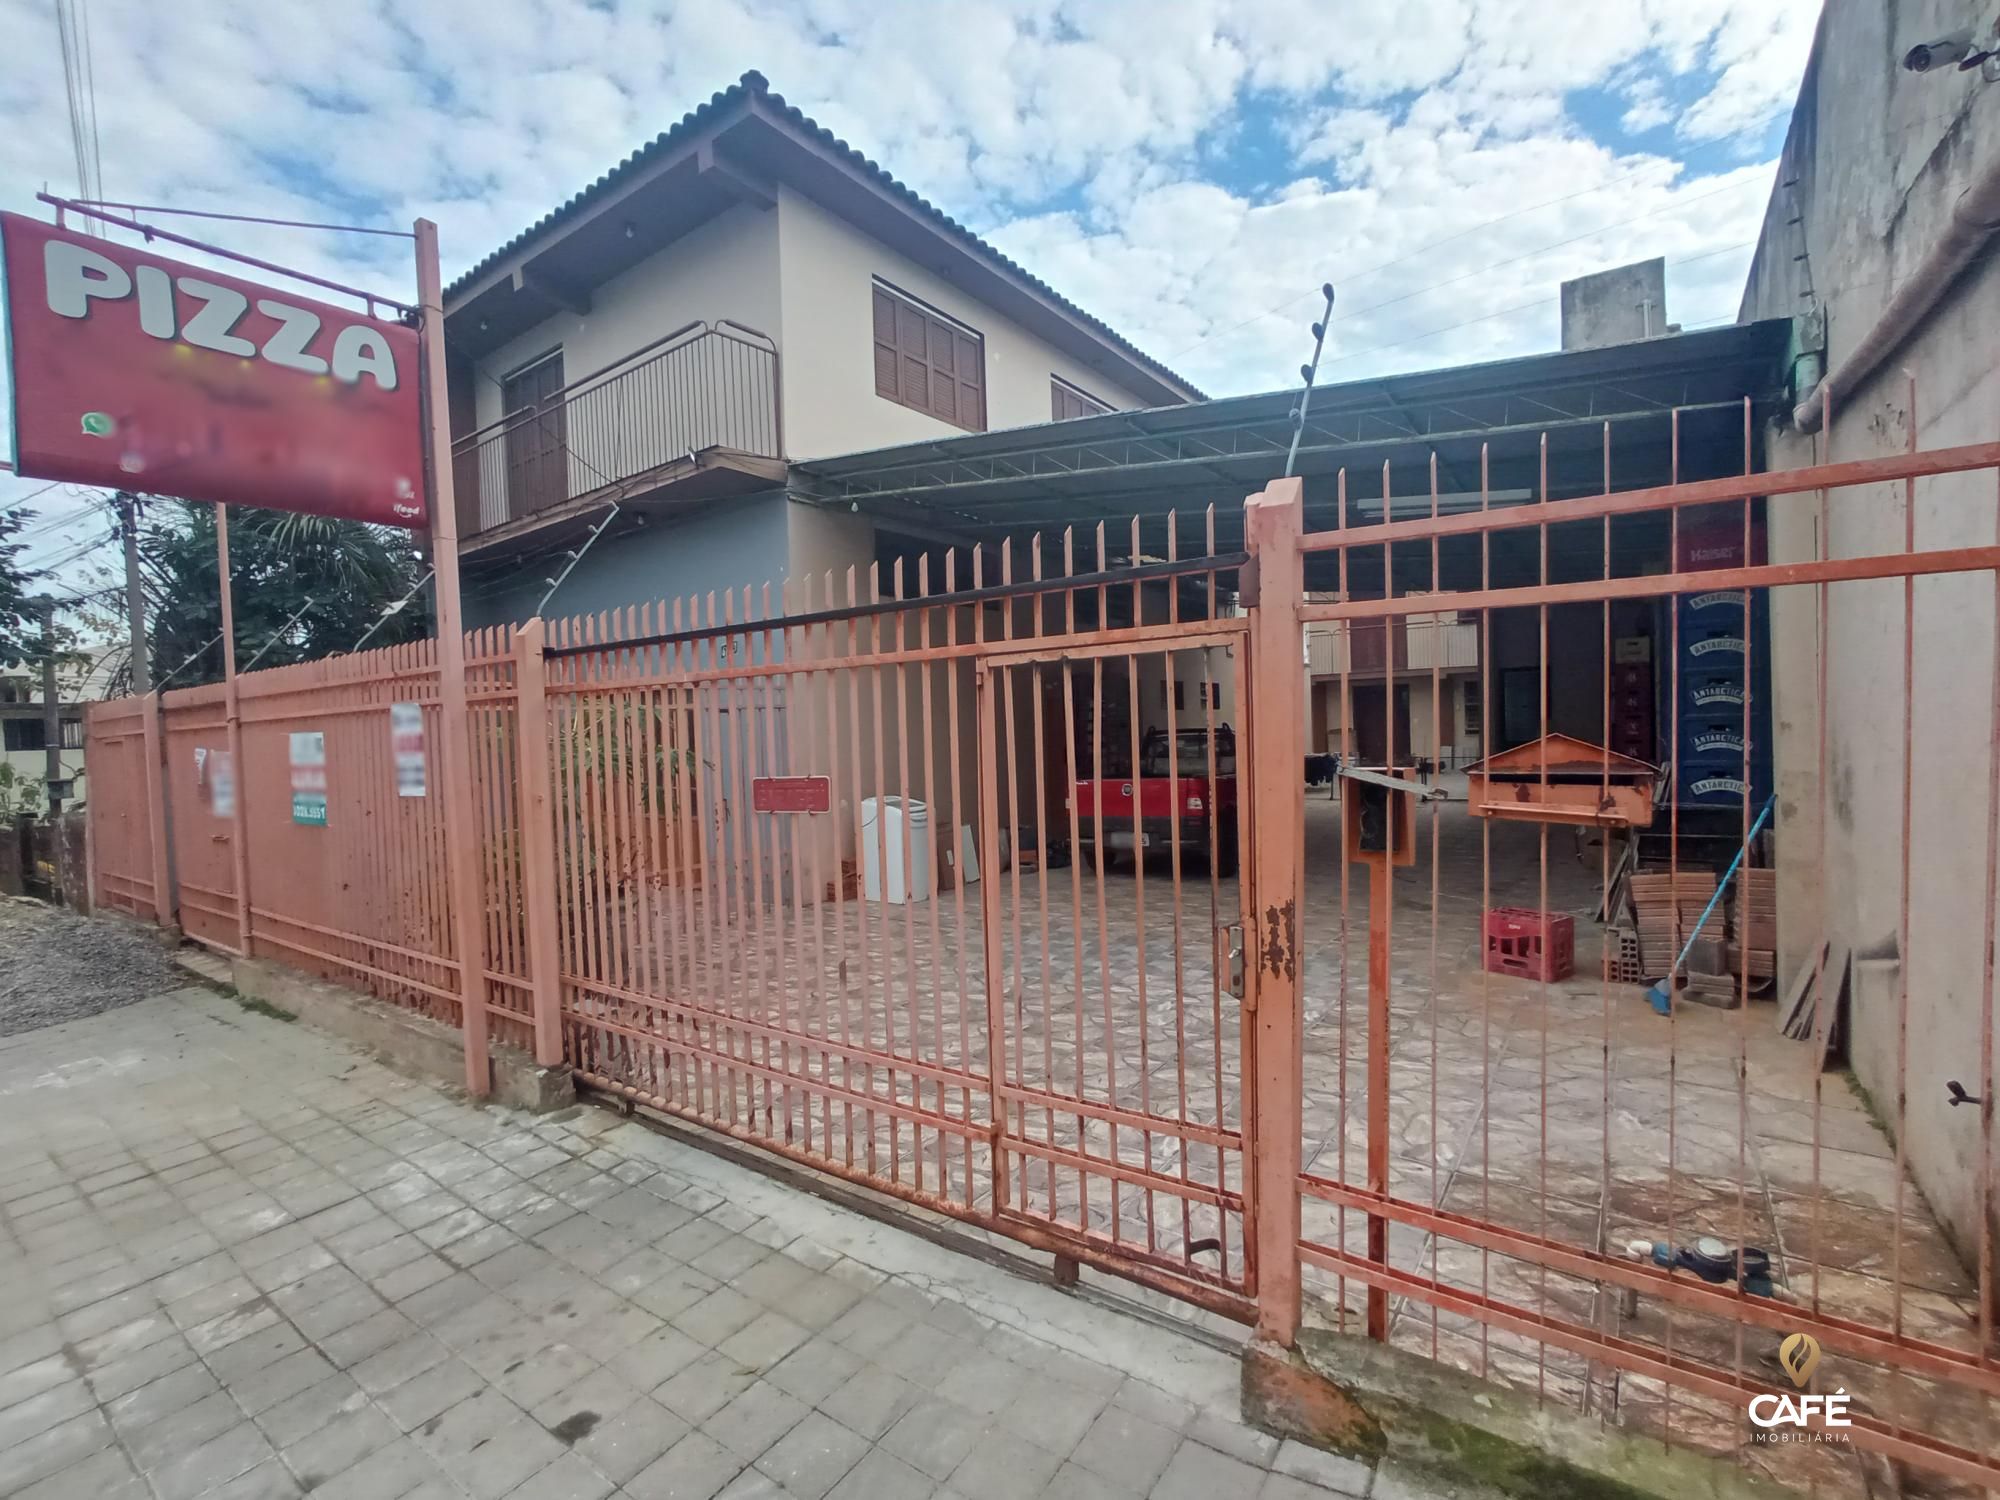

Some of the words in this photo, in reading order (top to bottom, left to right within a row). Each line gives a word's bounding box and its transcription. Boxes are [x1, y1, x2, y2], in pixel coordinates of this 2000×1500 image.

[44, 240, 398, 390] PIZZA
[1692, 639, 1748, 655] ANTARCTIC
[1694, 780, 1748, 793] ANTARCTIC
